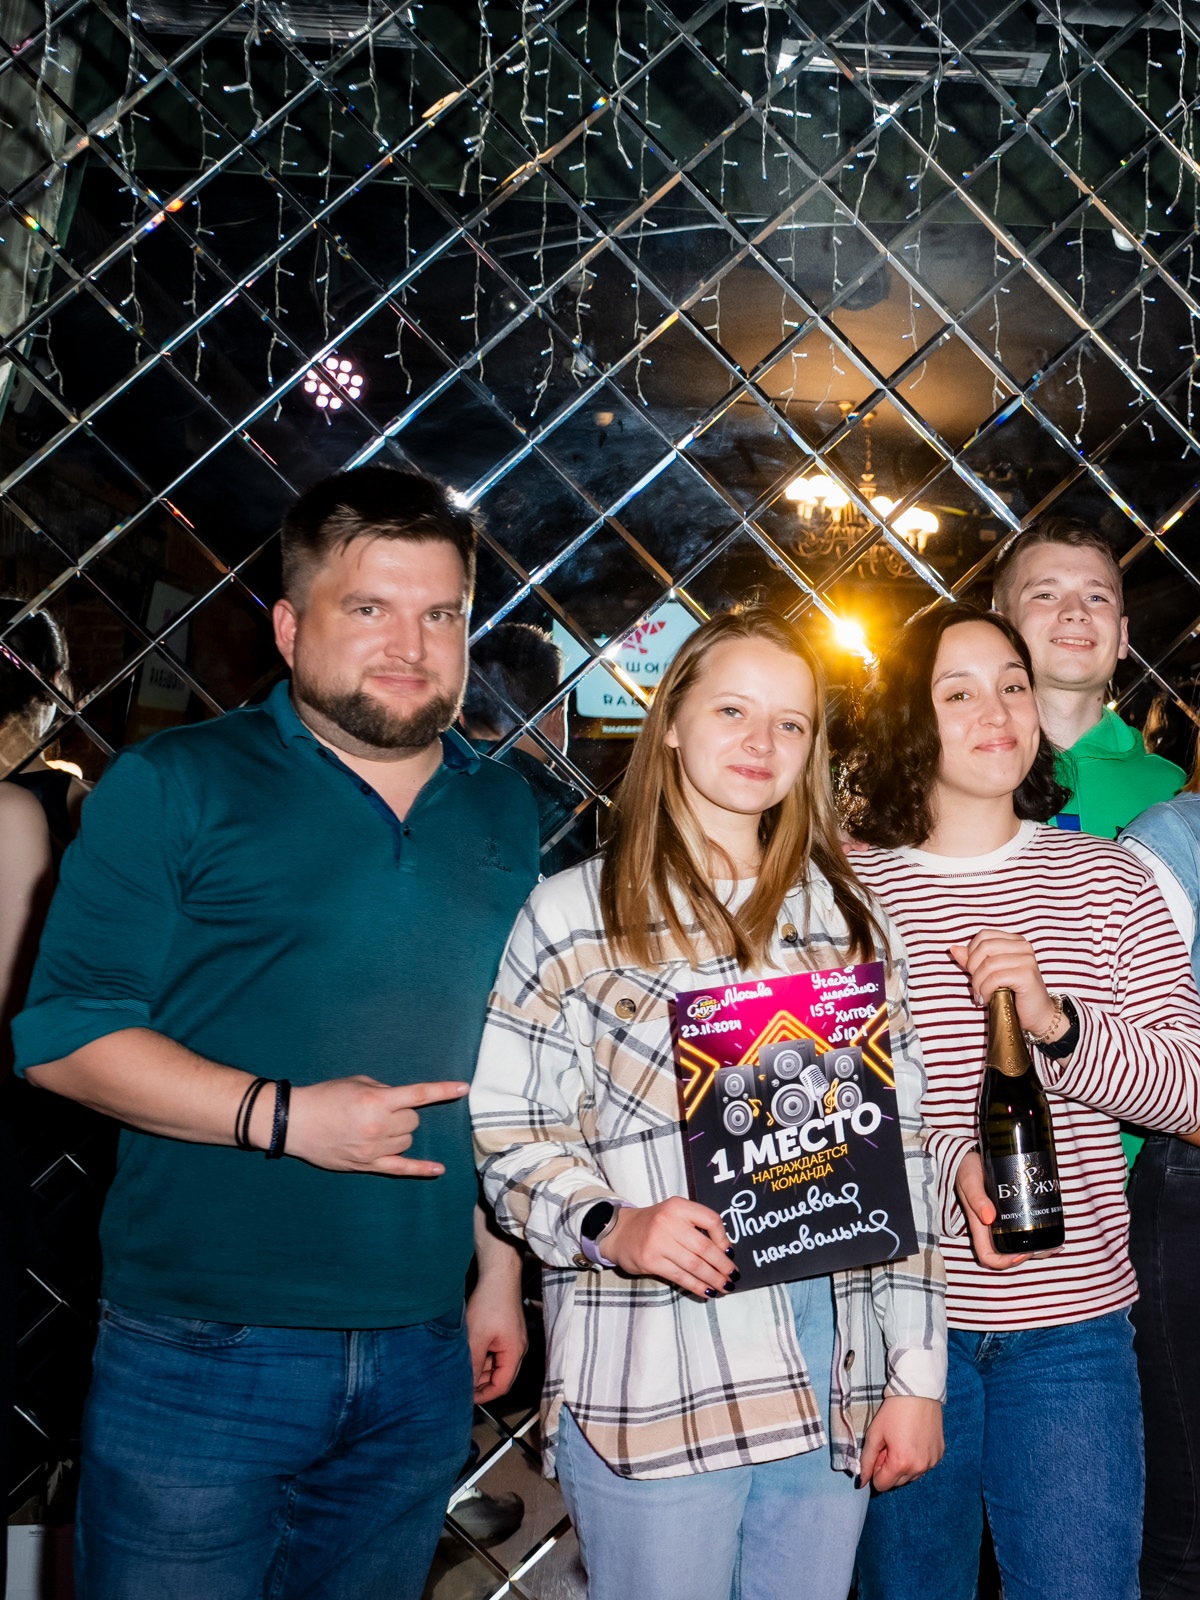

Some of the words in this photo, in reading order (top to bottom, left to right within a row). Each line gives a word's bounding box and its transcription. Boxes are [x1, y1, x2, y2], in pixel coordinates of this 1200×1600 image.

[811, 965, 857, 990] Угадай
[720, 981, 773, 1007] Москва
[809, 1001, 836, 1018] 155
[681, 1020, 742, 1038] 23.11.2024
[709, 1148, 735, 1184] 1
[743, 1102, 882, 1174] МЕСТО
[752, 1143, 849, 1185] НАГРАЖДАЕТСЯ
[771, 1163, 834, 1192] КОМАНДА
[720, 1182, 862, 1244] Плюшевая
[752, 1209, 901, 1267] наковальня
